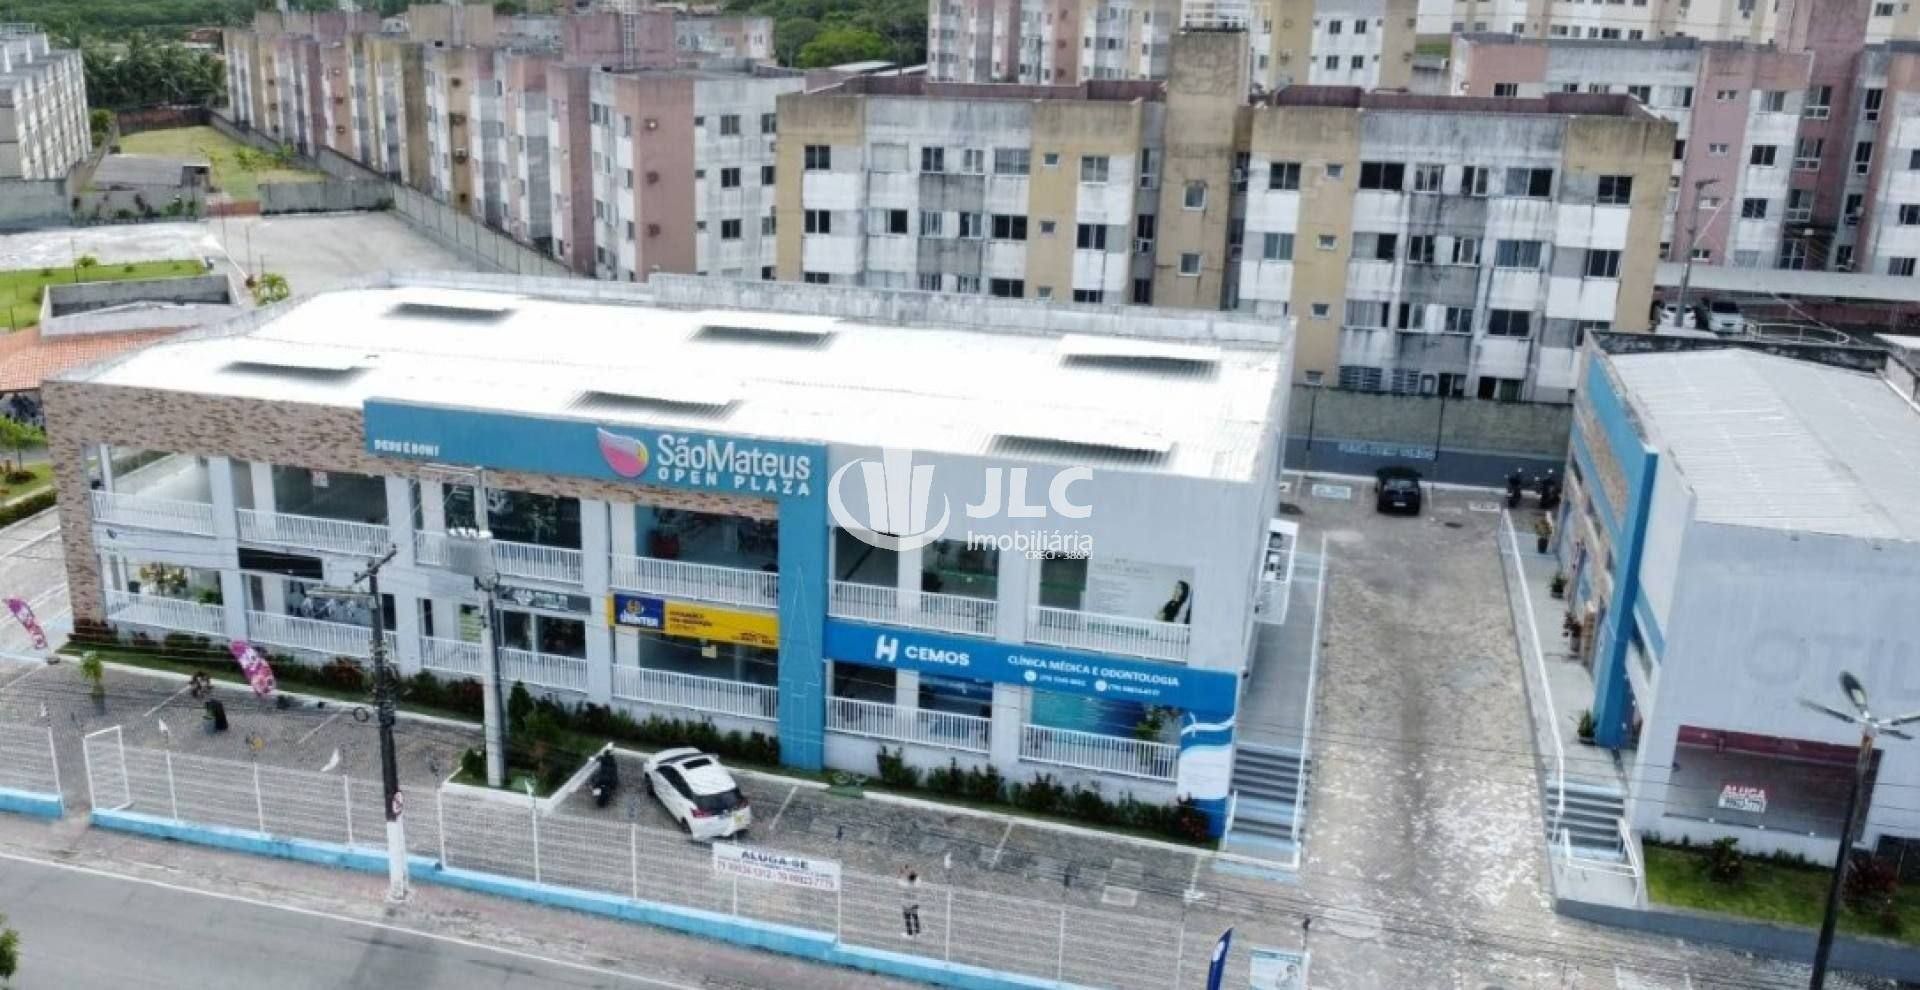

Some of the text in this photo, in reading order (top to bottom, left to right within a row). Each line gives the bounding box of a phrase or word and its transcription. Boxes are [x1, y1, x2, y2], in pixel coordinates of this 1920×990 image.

[657, 434, 812, 480] SãoMateus
[658, 467, 810, 496] OPEN PLAZA
[904, 646, 970, 666] CEMOS
[1007, 654, 1047, 669] CLÍNICA
[1049, 661, 1090, 675] MÉDICA
[1092, 666, 1099, 676] E
[1100, 667, 1180, 687] ODONTOLOGIA
